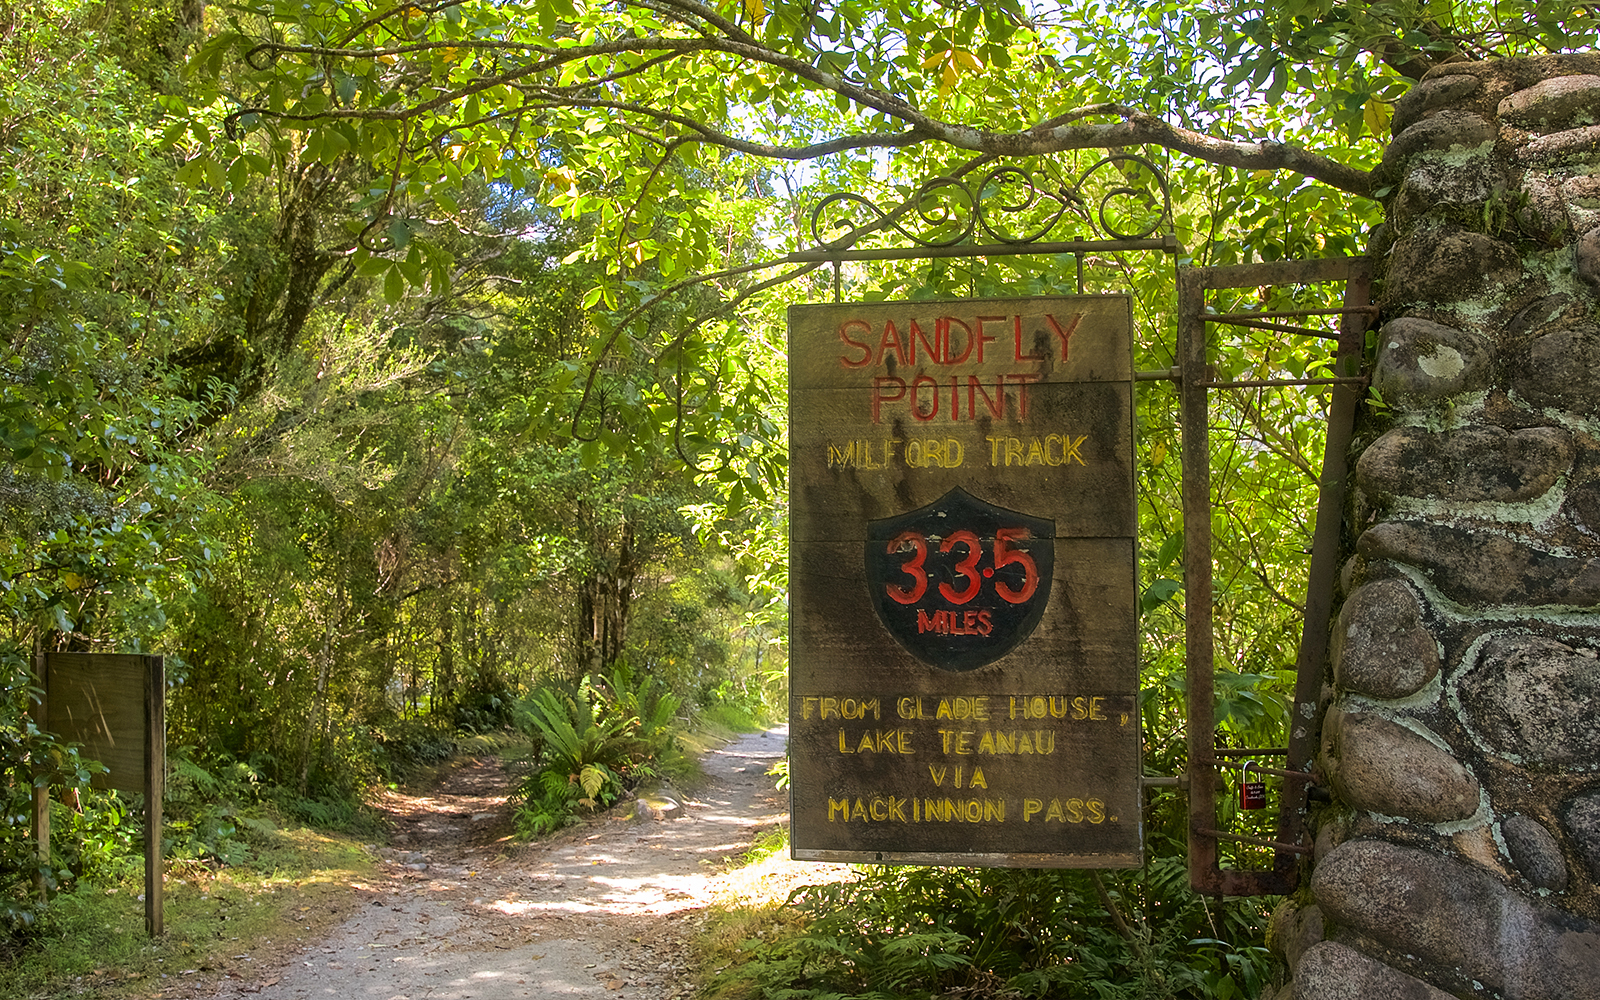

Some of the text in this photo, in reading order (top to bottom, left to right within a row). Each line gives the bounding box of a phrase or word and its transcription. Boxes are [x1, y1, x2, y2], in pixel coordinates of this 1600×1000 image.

[839, 314, 1083, 368] SANDFLY
[871, 373, 1042, 424] POINT
[827, 434, 1088, 469] MILFORD TRACK
[917, 609, 993, 637] MILES
[802, 696, 880, 720] FROM
[897, 696, 991, 721] GLADE
[838, 727, 916, 754] LAKE
[928, 763, 988, 789] VIA
[827, 796, 1119, 824] MACKINNON PASS.
